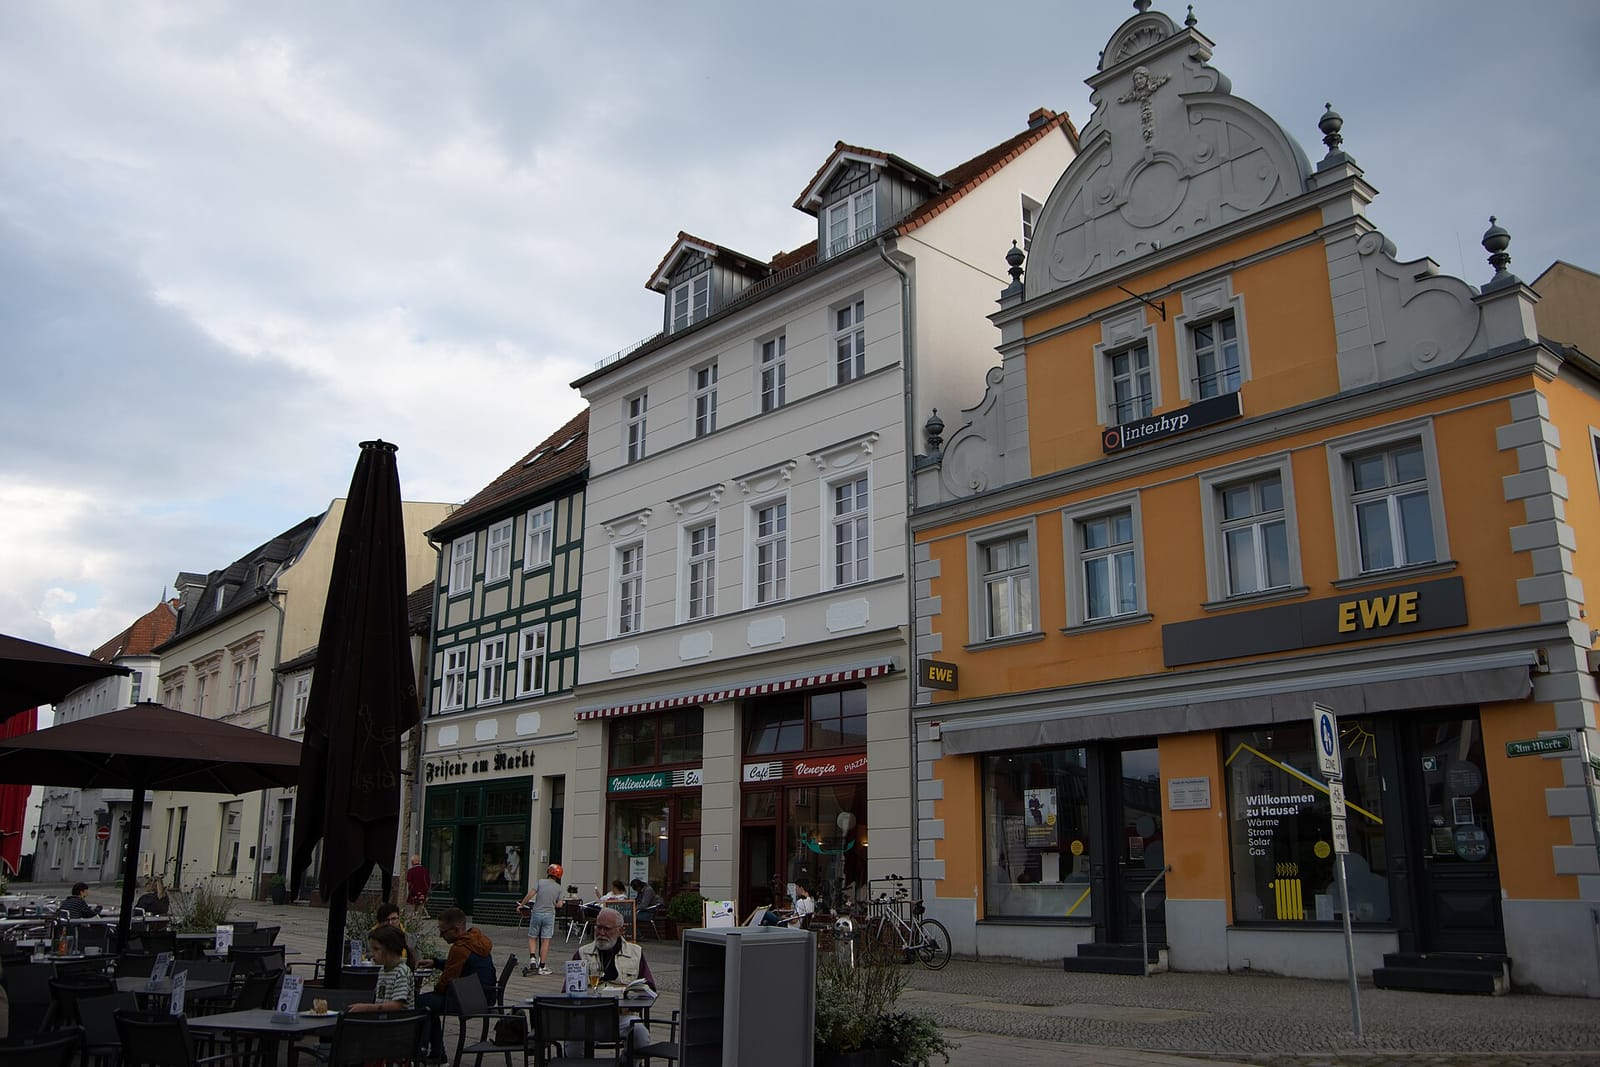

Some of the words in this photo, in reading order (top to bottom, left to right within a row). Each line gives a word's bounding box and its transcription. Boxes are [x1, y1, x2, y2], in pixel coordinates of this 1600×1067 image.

[1126, 413, 1190, 441] interhyp
[1338, 591, 1418, 633] EWE
[928, 665, 953, 683] EWE
[1514, 743, 1531, 753] Am
[1532, 740, 1562, 751] Markt
[472, 759, 488, 773] am
[494, 750, 535, 771] Markt
[795, 762, 837, 777] Venezia
[612, 774, 663, 791] Italienisches
[685, 771, 699, 785] Eis
[1246, 794, 1315, 806] Willkommen
[1246, 808, 1259, 817] zu
[1261, 805, 1300, 816] Hause!
[1247, 818, 1280, 827] Wärme
[1247, 828, 1274, 837] Strom
[1248, 838, 1271, 846] Solar
[1248, 847, 1266, 856] Gas
